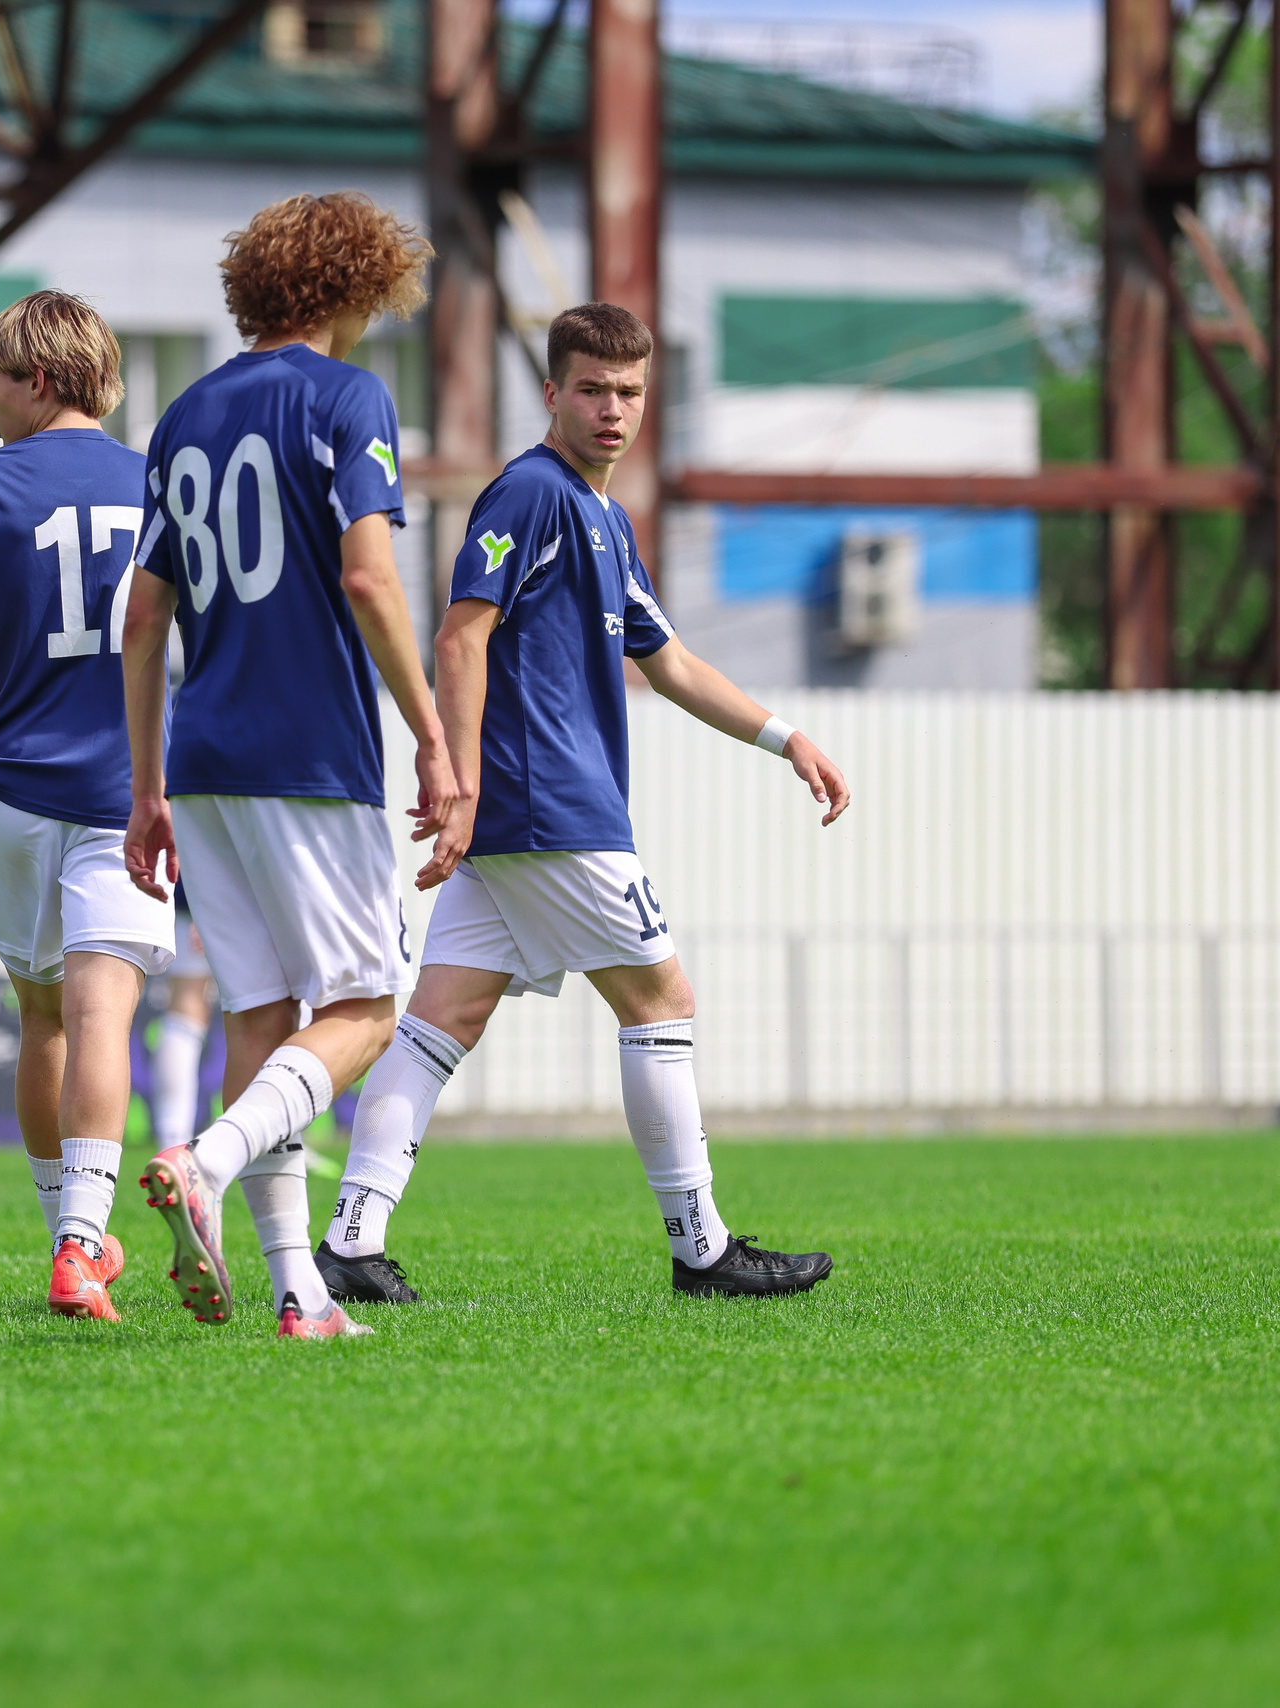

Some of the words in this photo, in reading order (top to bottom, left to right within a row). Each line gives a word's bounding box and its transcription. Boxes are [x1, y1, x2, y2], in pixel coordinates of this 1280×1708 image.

[34, 505, 144, 659] 17
[167, 433, 285, 614] 80
[623, 875, 668, 943] 19
